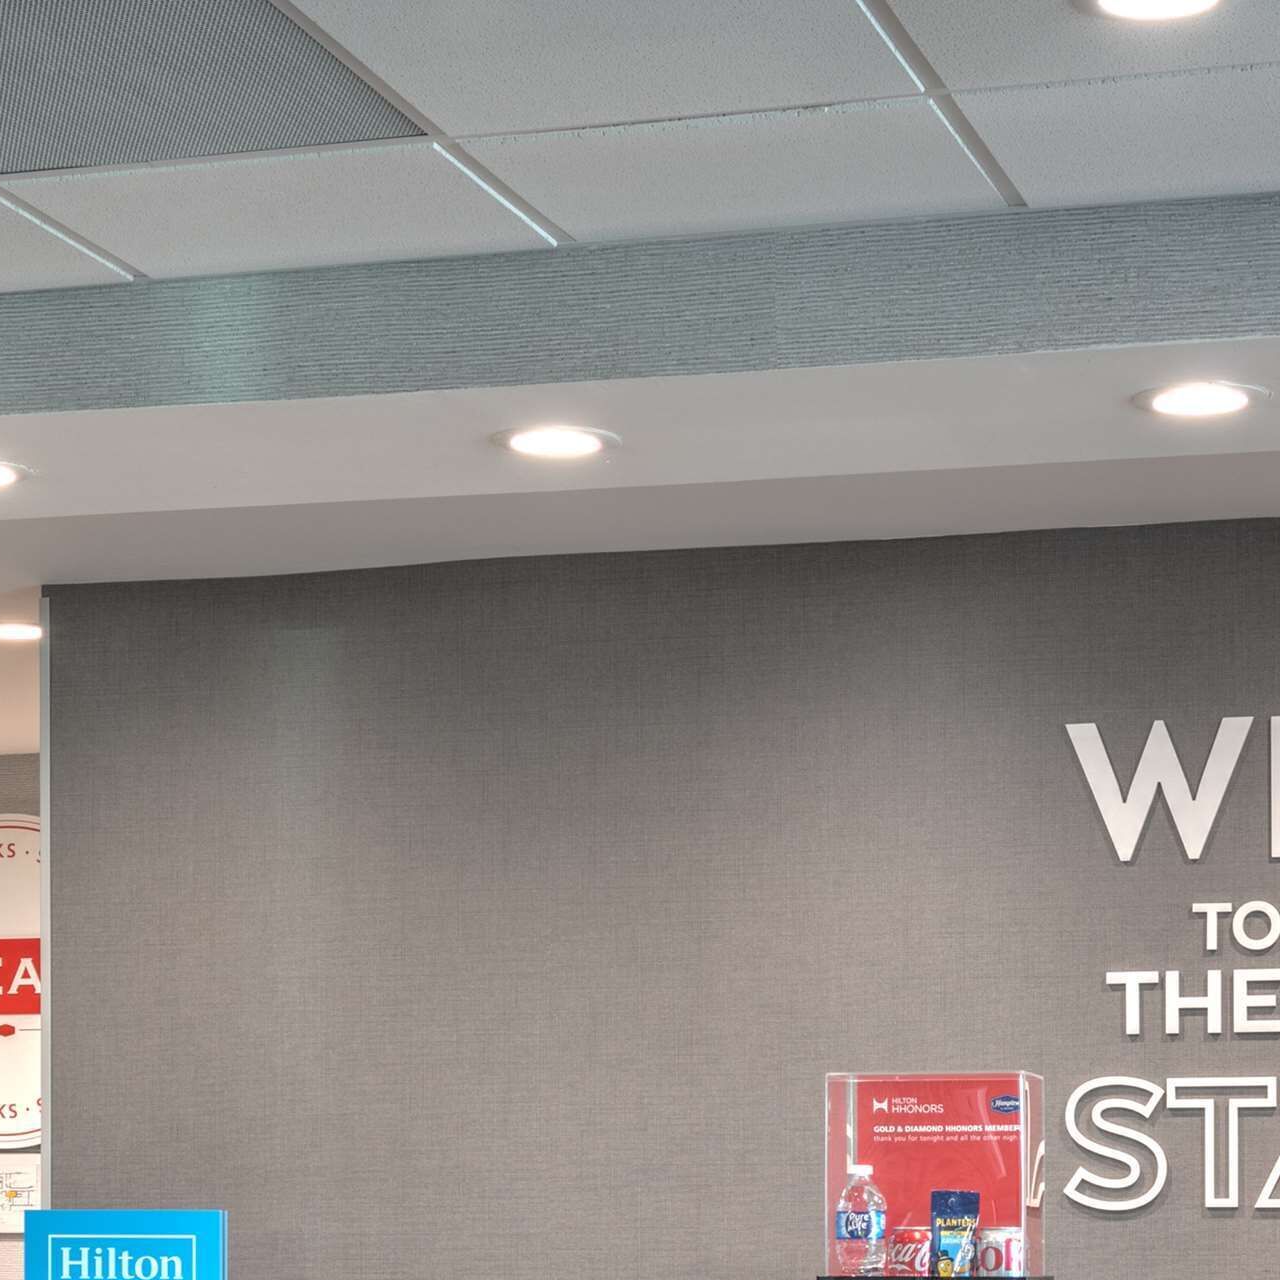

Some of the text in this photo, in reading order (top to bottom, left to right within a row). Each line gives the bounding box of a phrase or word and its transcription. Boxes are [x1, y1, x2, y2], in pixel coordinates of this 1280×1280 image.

[892, 1104, 944, 1113] HHONORS
[873, 1125, 895, 1133] GOLD
[945, 1124, 983, 1132] HHONORS
[60, 1247, 184, 1280] Hilton
